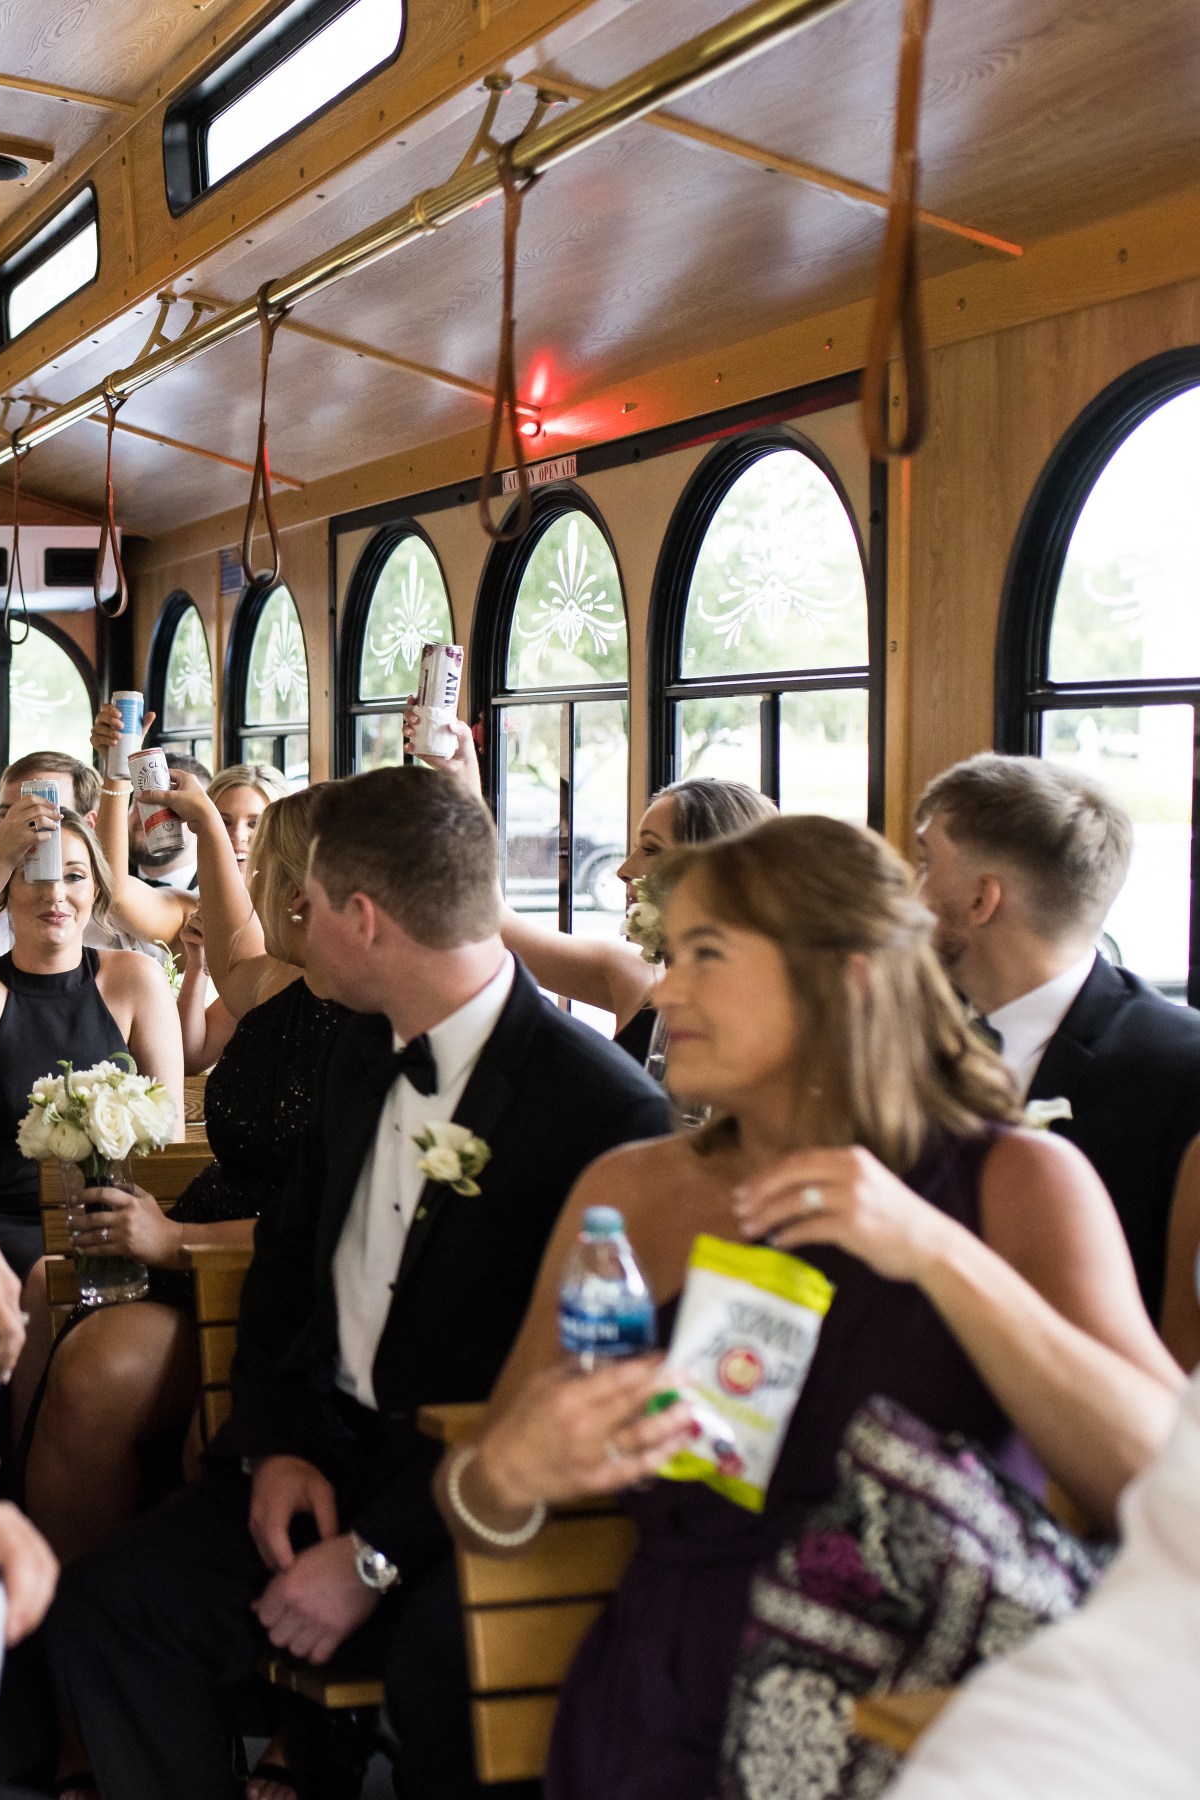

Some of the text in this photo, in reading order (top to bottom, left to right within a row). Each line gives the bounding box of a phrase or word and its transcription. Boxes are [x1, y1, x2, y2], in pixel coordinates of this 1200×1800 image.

[503, 458, 576, 491] CAUON OPEN AIR
